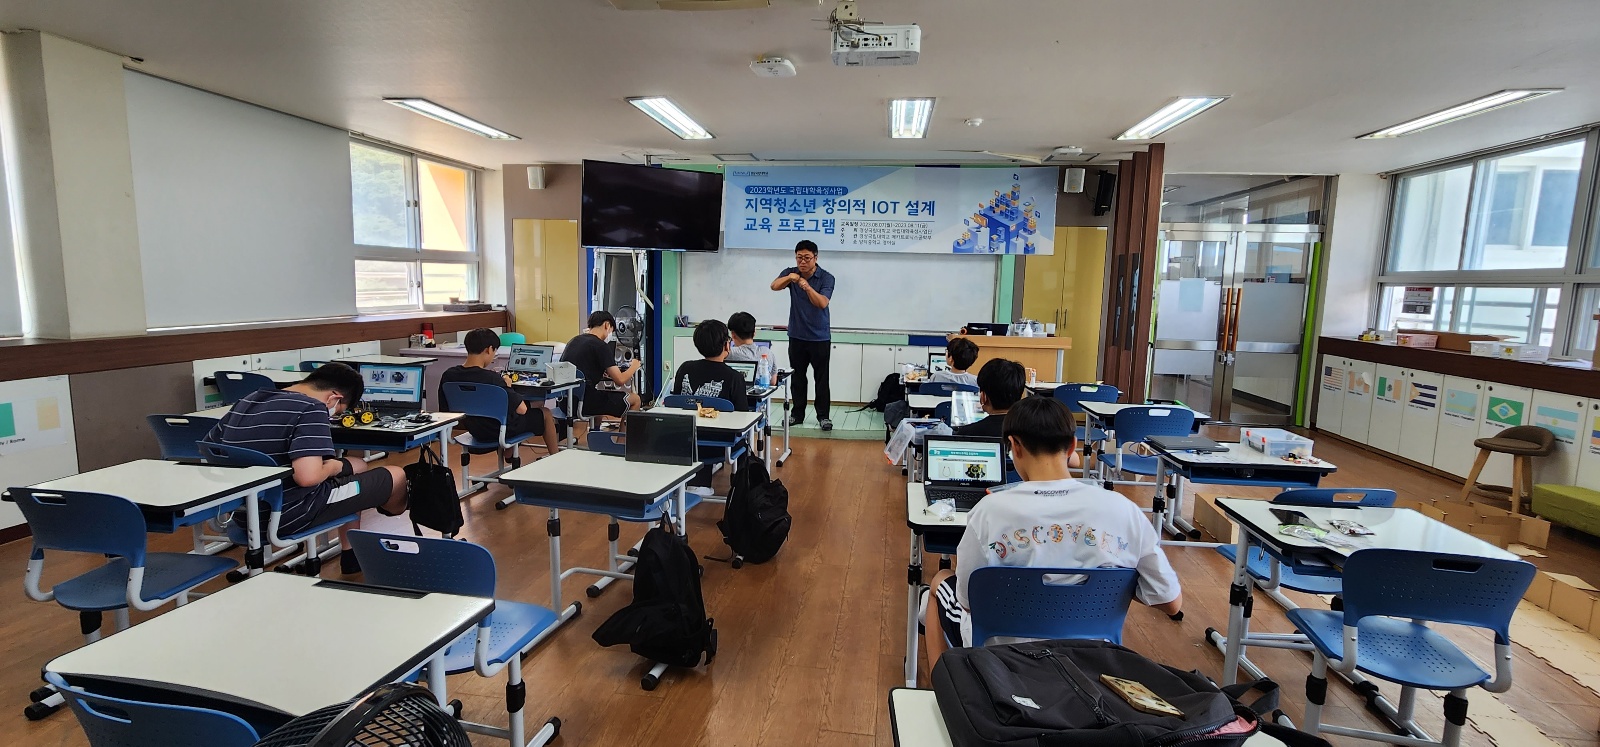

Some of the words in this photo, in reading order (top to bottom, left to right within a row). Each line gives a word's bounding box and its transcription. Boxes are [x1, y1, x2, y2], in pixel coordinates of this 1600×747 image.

[749, 186, 787, 195] 2023학년도
[789, 186, 843, 195] 국립대학육성사업
[745, 197, 817, 214] 지역청소년
[822, 197, 866, 215] 창의적
[872, 200, 900, 214] IOT
[905, 200, 936, 216] 설계
[743, 217, 773, 233] 교육
[777, 218, 836, 234] 프로그램
